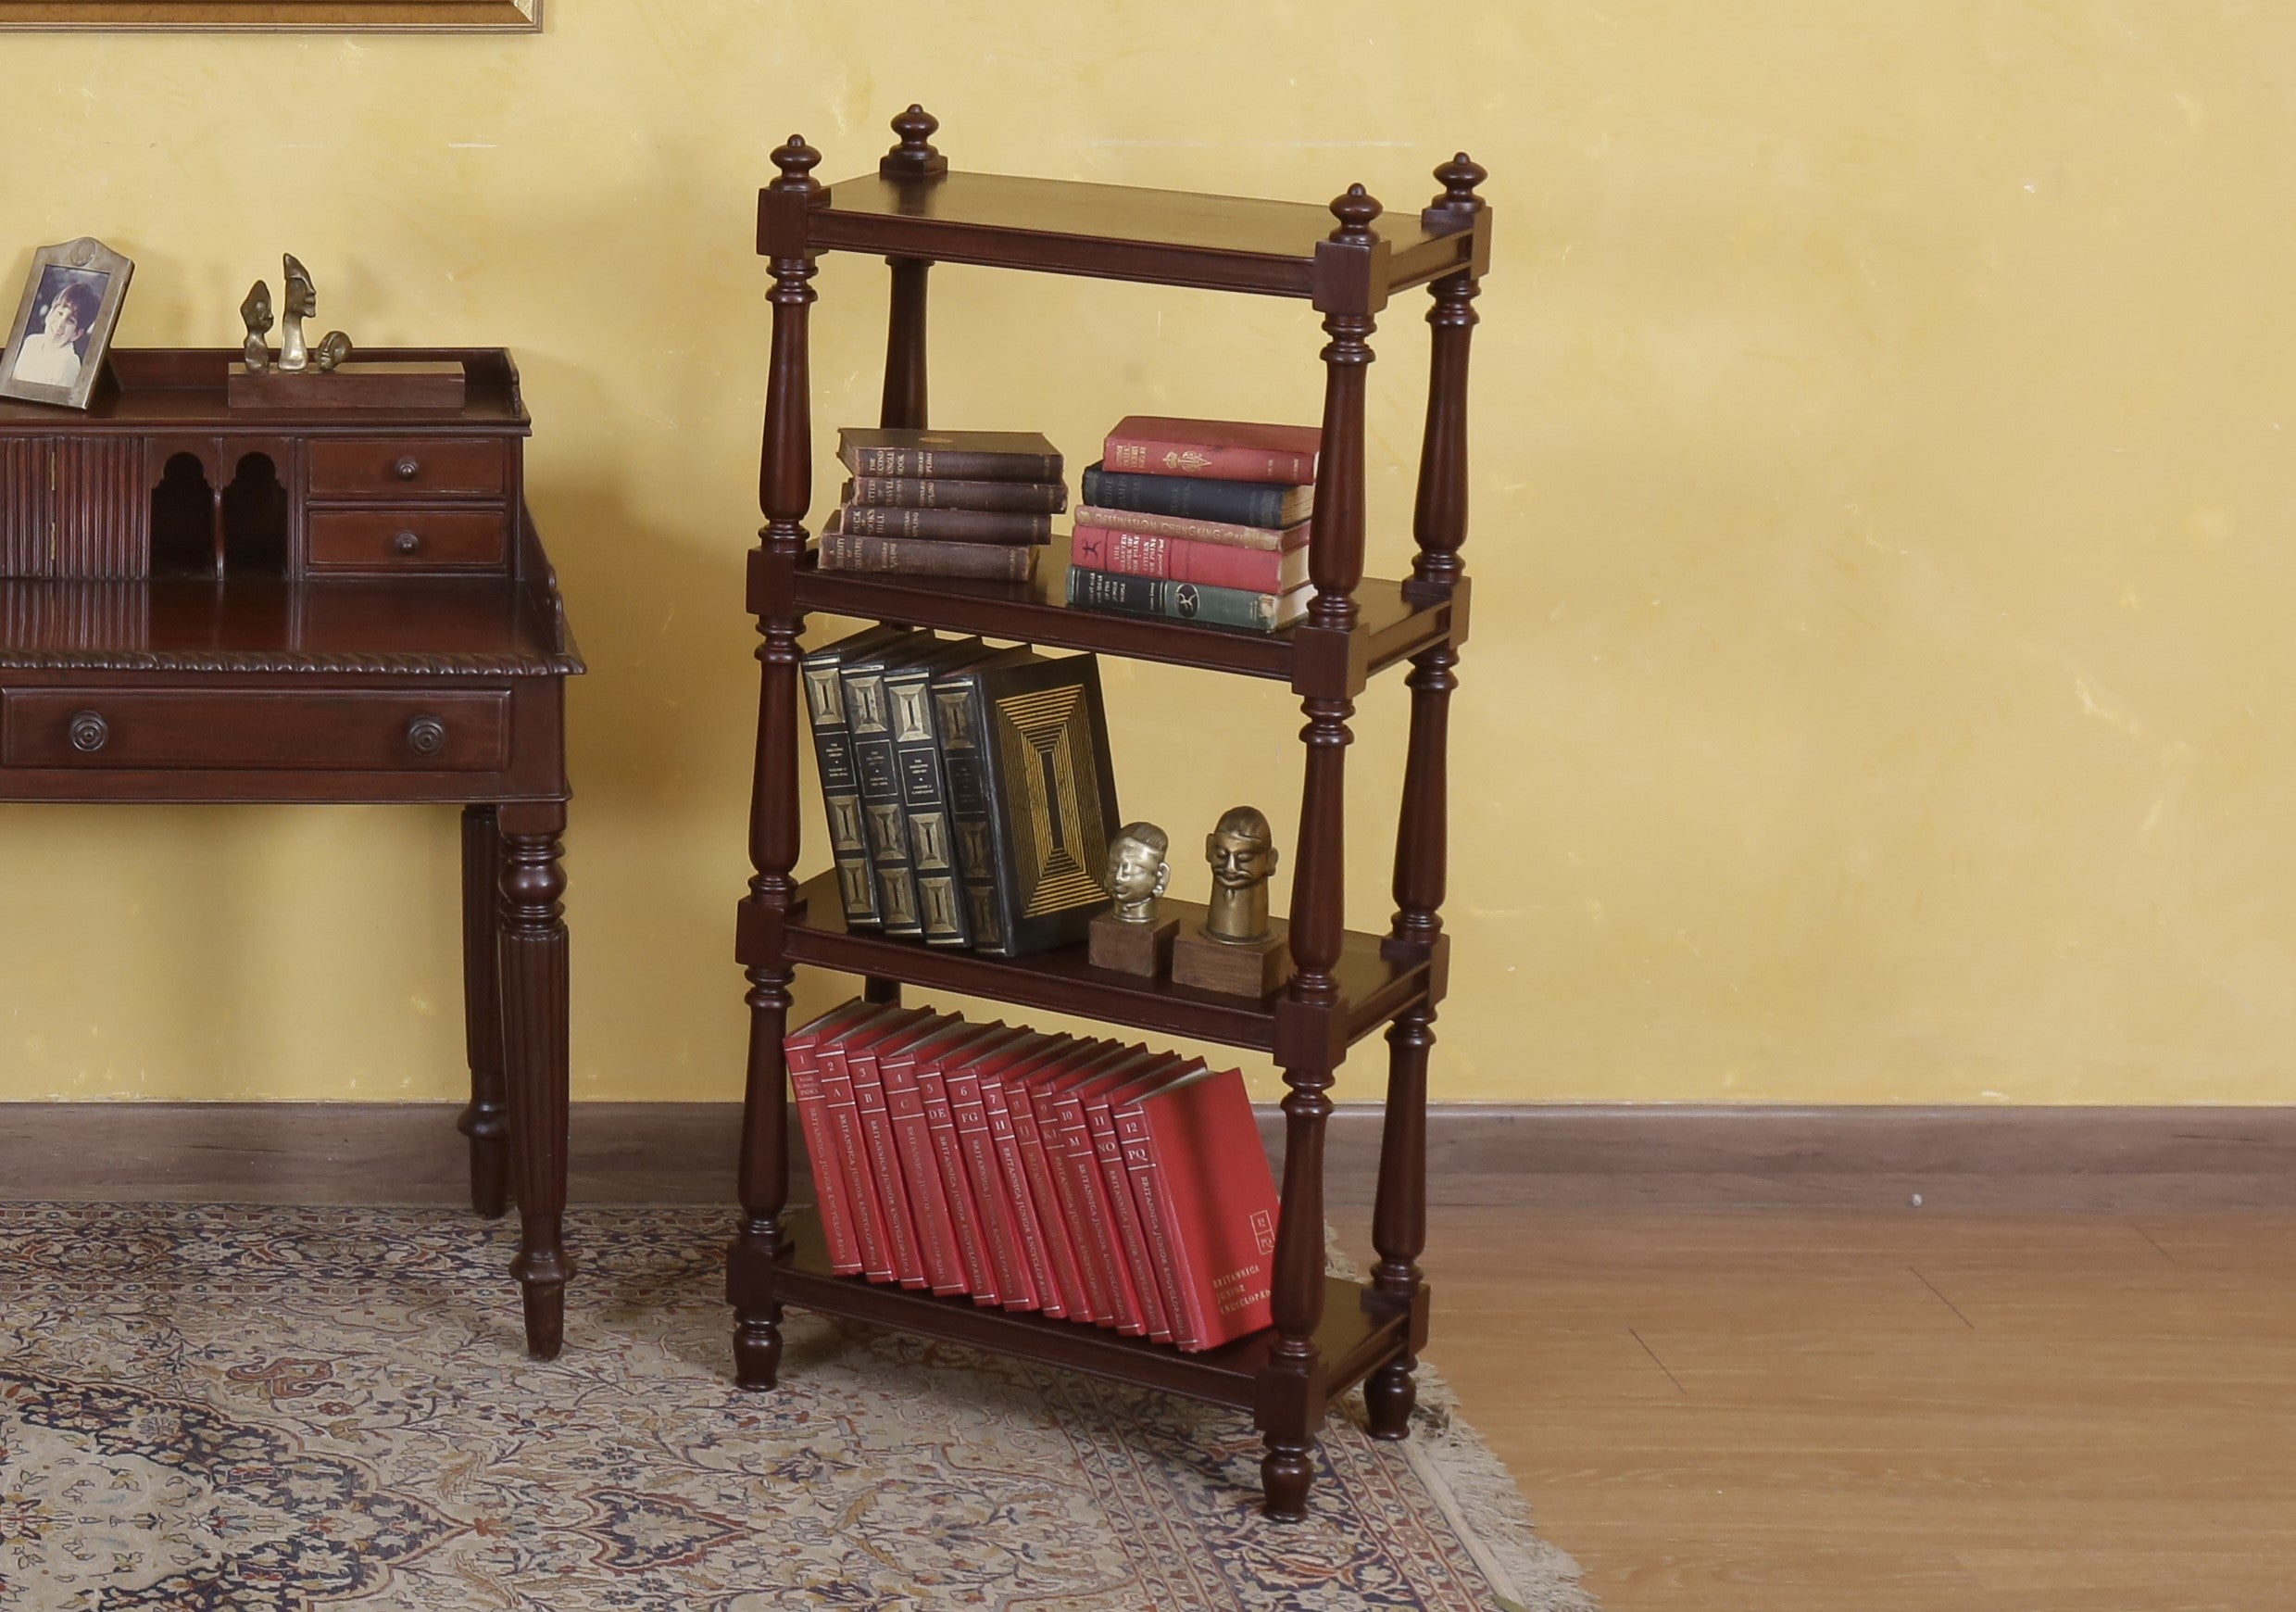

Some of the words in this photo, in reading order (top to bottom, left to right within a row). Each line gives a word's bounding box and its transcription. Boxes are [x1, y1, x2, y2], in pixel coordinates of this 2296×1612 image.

[827, 1061, 834, 1071] 2
[859, 1067, 866, 1077] 3
[834, 1088, 841, 1097] A
[927, 1083, 934, 1093] 5
[960, 1086, 968, 1096] 6
[864, 1093, 872, 1103] B
[989, 1094, 997, 1104] 7
[900, 1100, 909, 1109] C
[929, 1108, 947, 1120] DE
[961, 1112, 978, 1123] FG
[1061, 1111, 1073, 1121] 10
[1094, 1115, 1105, 1127] 11
[1126, 1122, 1137, 1133] 12
[1069, 1136, 1080, 1147] M
[1098, 1142, 1115, 1152] NO
[839, 1113, 855, 1165] BRITANNICA
[849, 1166, 862, 1199] JUNIOR
[1128, 1149, 1148, 1162] PQ
[870, 1119, 886, 1170] BRITANNICA
[881, 1172, 895, 1204] JUNIOR
[939, 1135, 958, 1187] BRITANNICA
[951, 1189, 966, 1221] JUNIOR
[1002, 1146, 1022, 1198] BRITANNICA
[1015, 1200, 1031, 1233] JUNIOR
[1079, 1163, 1098, 1215] BRITANNICA
[1109, 1169, 1128, 1222] BRITANNICA
[1141, 1176, 1160, 1229] BRITANNICA
[1153, 1229, 1167, 1264] JUNIOR
[1212, 1265, 1260, 1289] BRITANNICA
